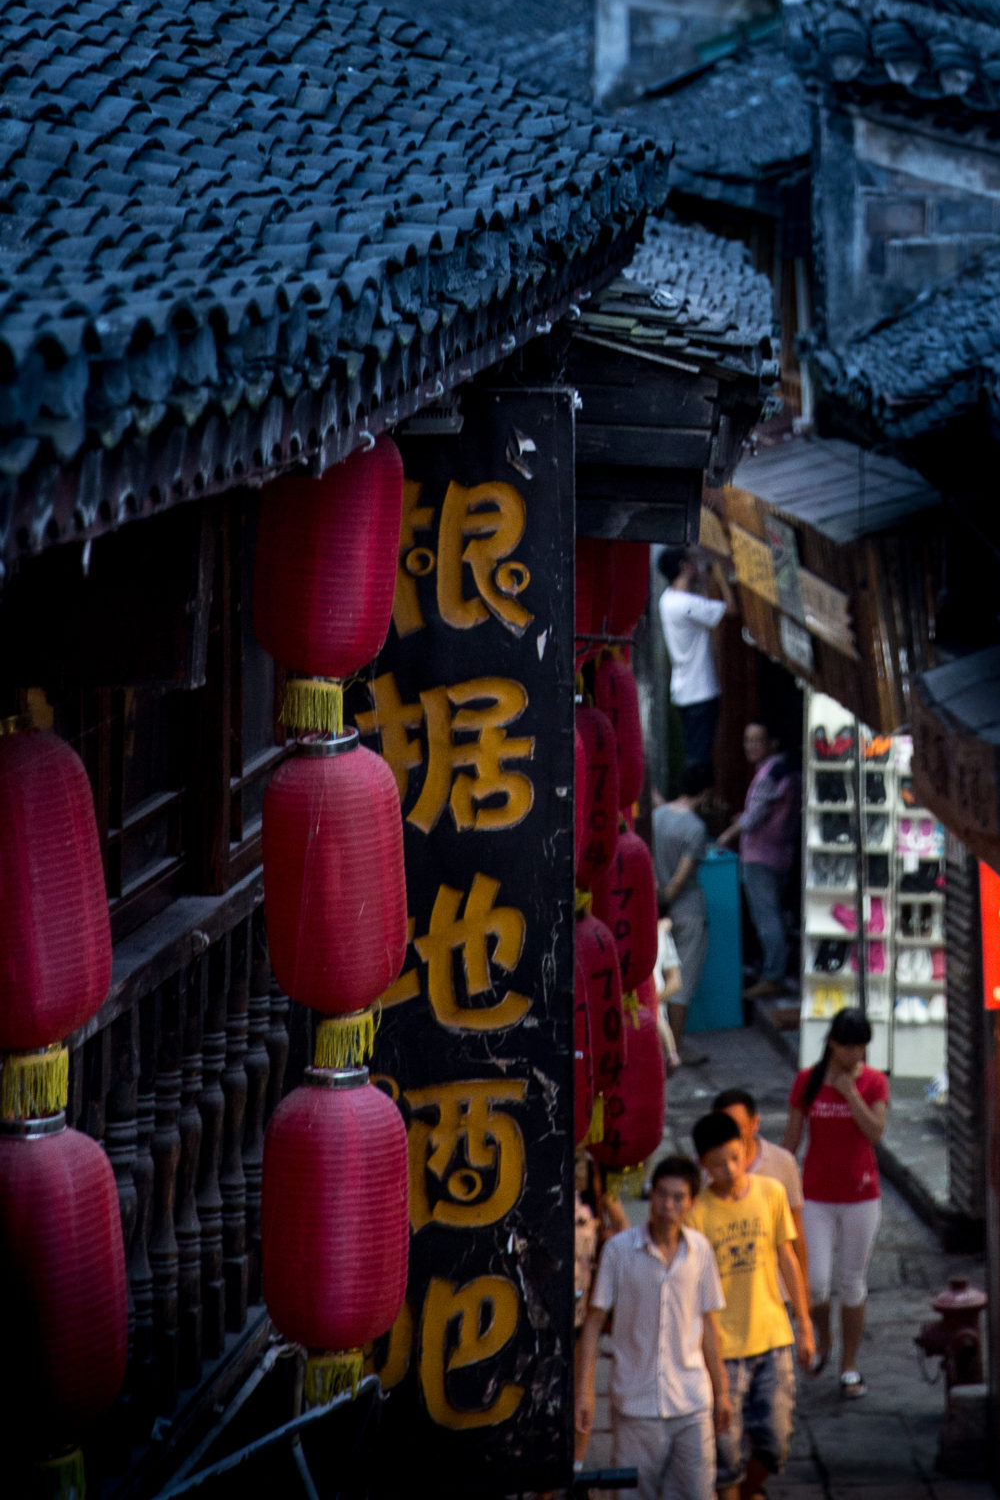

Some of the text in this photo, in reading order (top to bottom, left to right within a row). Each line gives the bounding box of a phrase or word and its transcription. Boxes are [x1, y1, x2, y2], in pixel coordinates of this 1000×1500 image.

[355, 479, 535, 1431] 根据地酒吧
